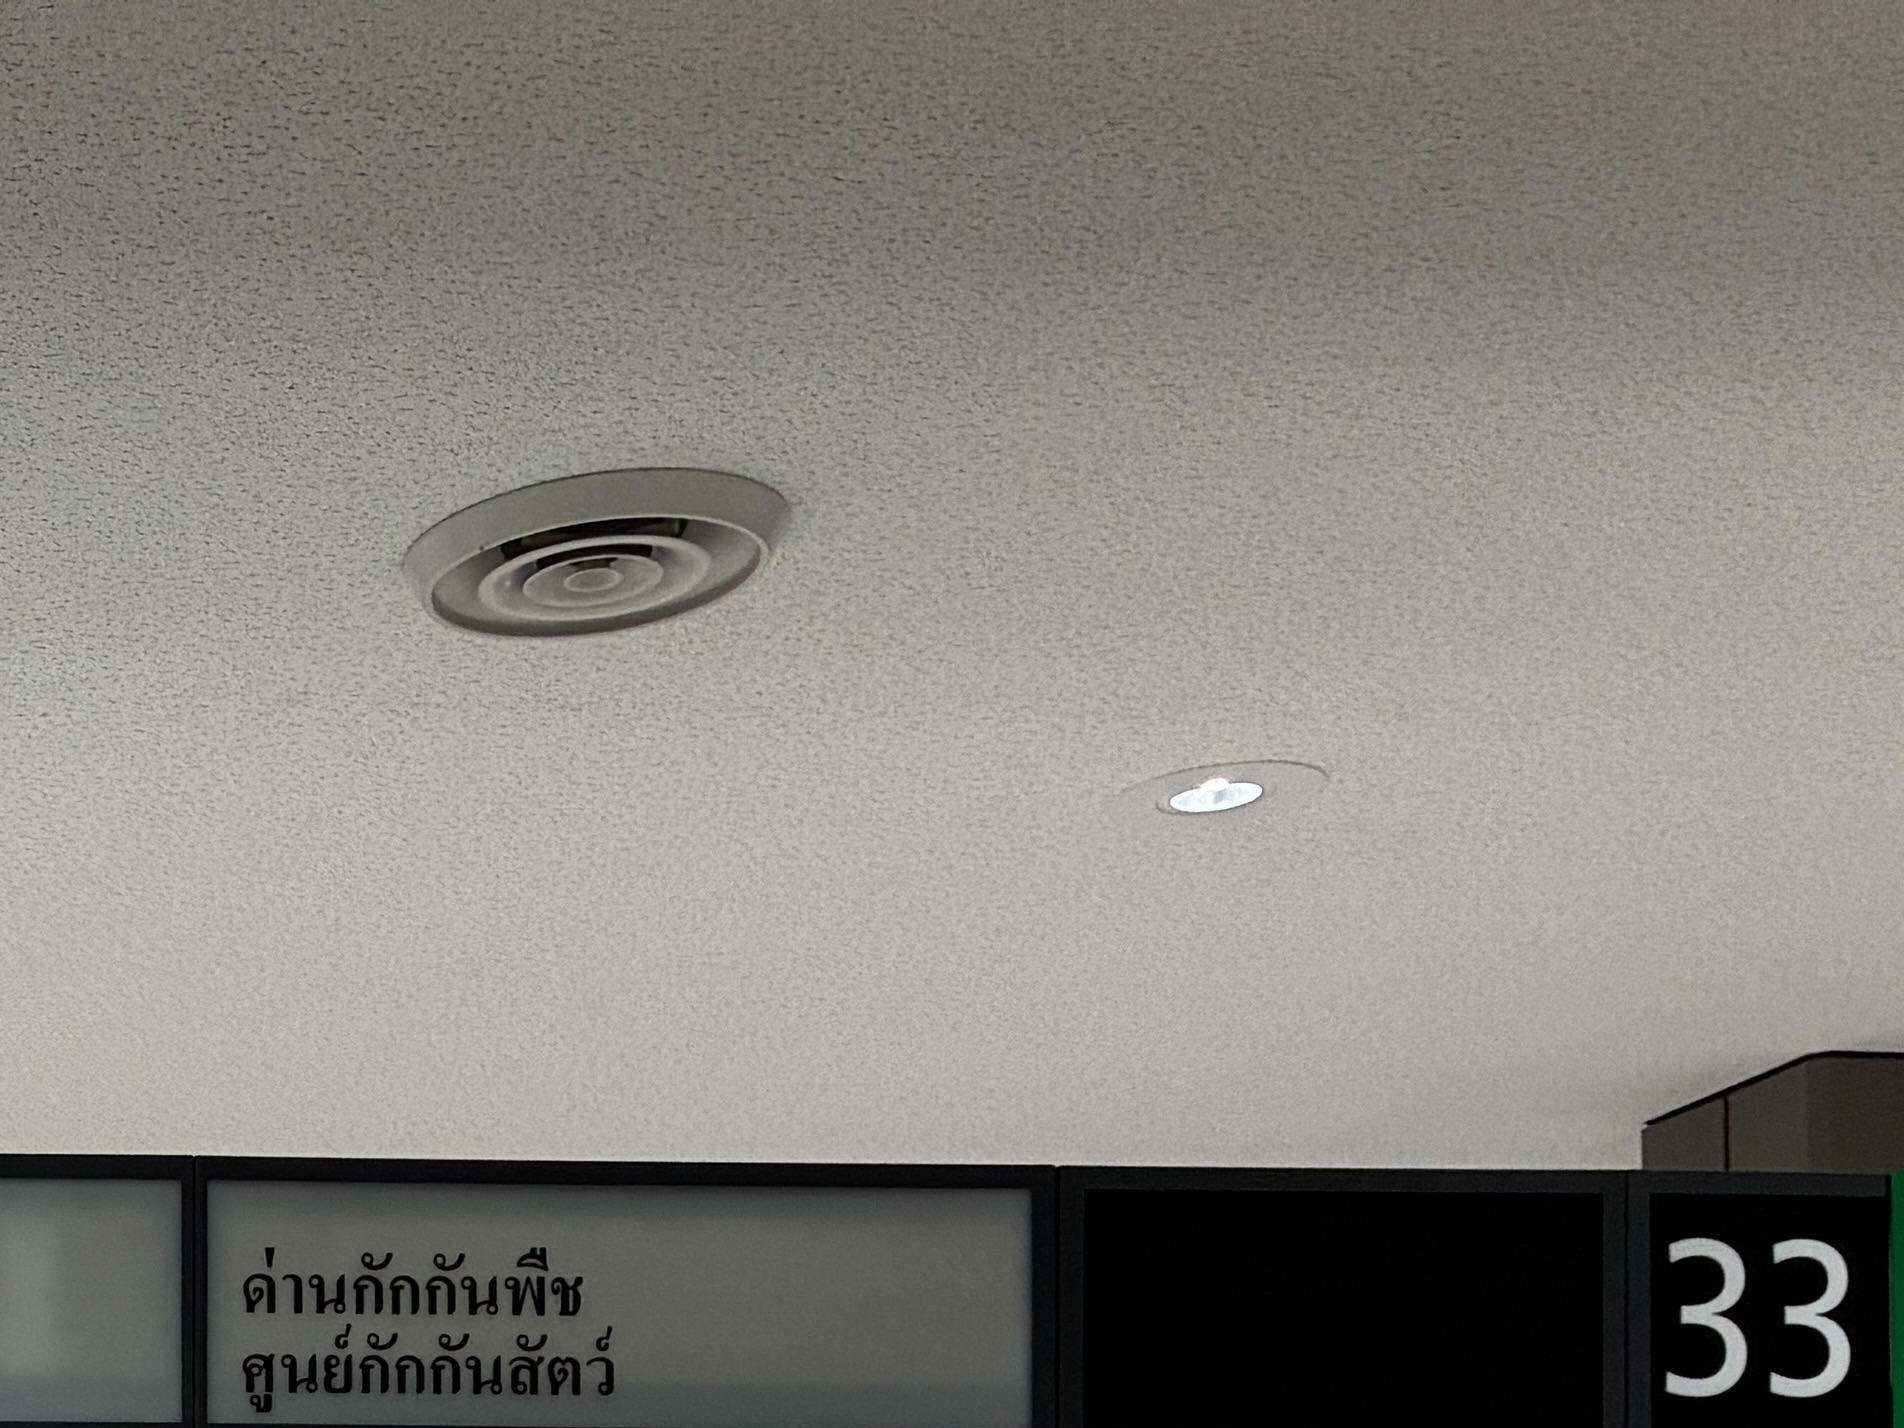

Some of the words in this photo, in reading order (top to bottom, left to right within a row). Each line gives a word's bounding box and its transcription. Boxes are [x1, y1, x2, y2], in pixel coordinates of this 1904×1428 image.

[243, 1247, 584, 1318] ด่านกักกันพืช
[1665, 1238, 1852, 1399] 33
[242, 1326, 616, 1414] ศูนย์กักกันสัตว์
